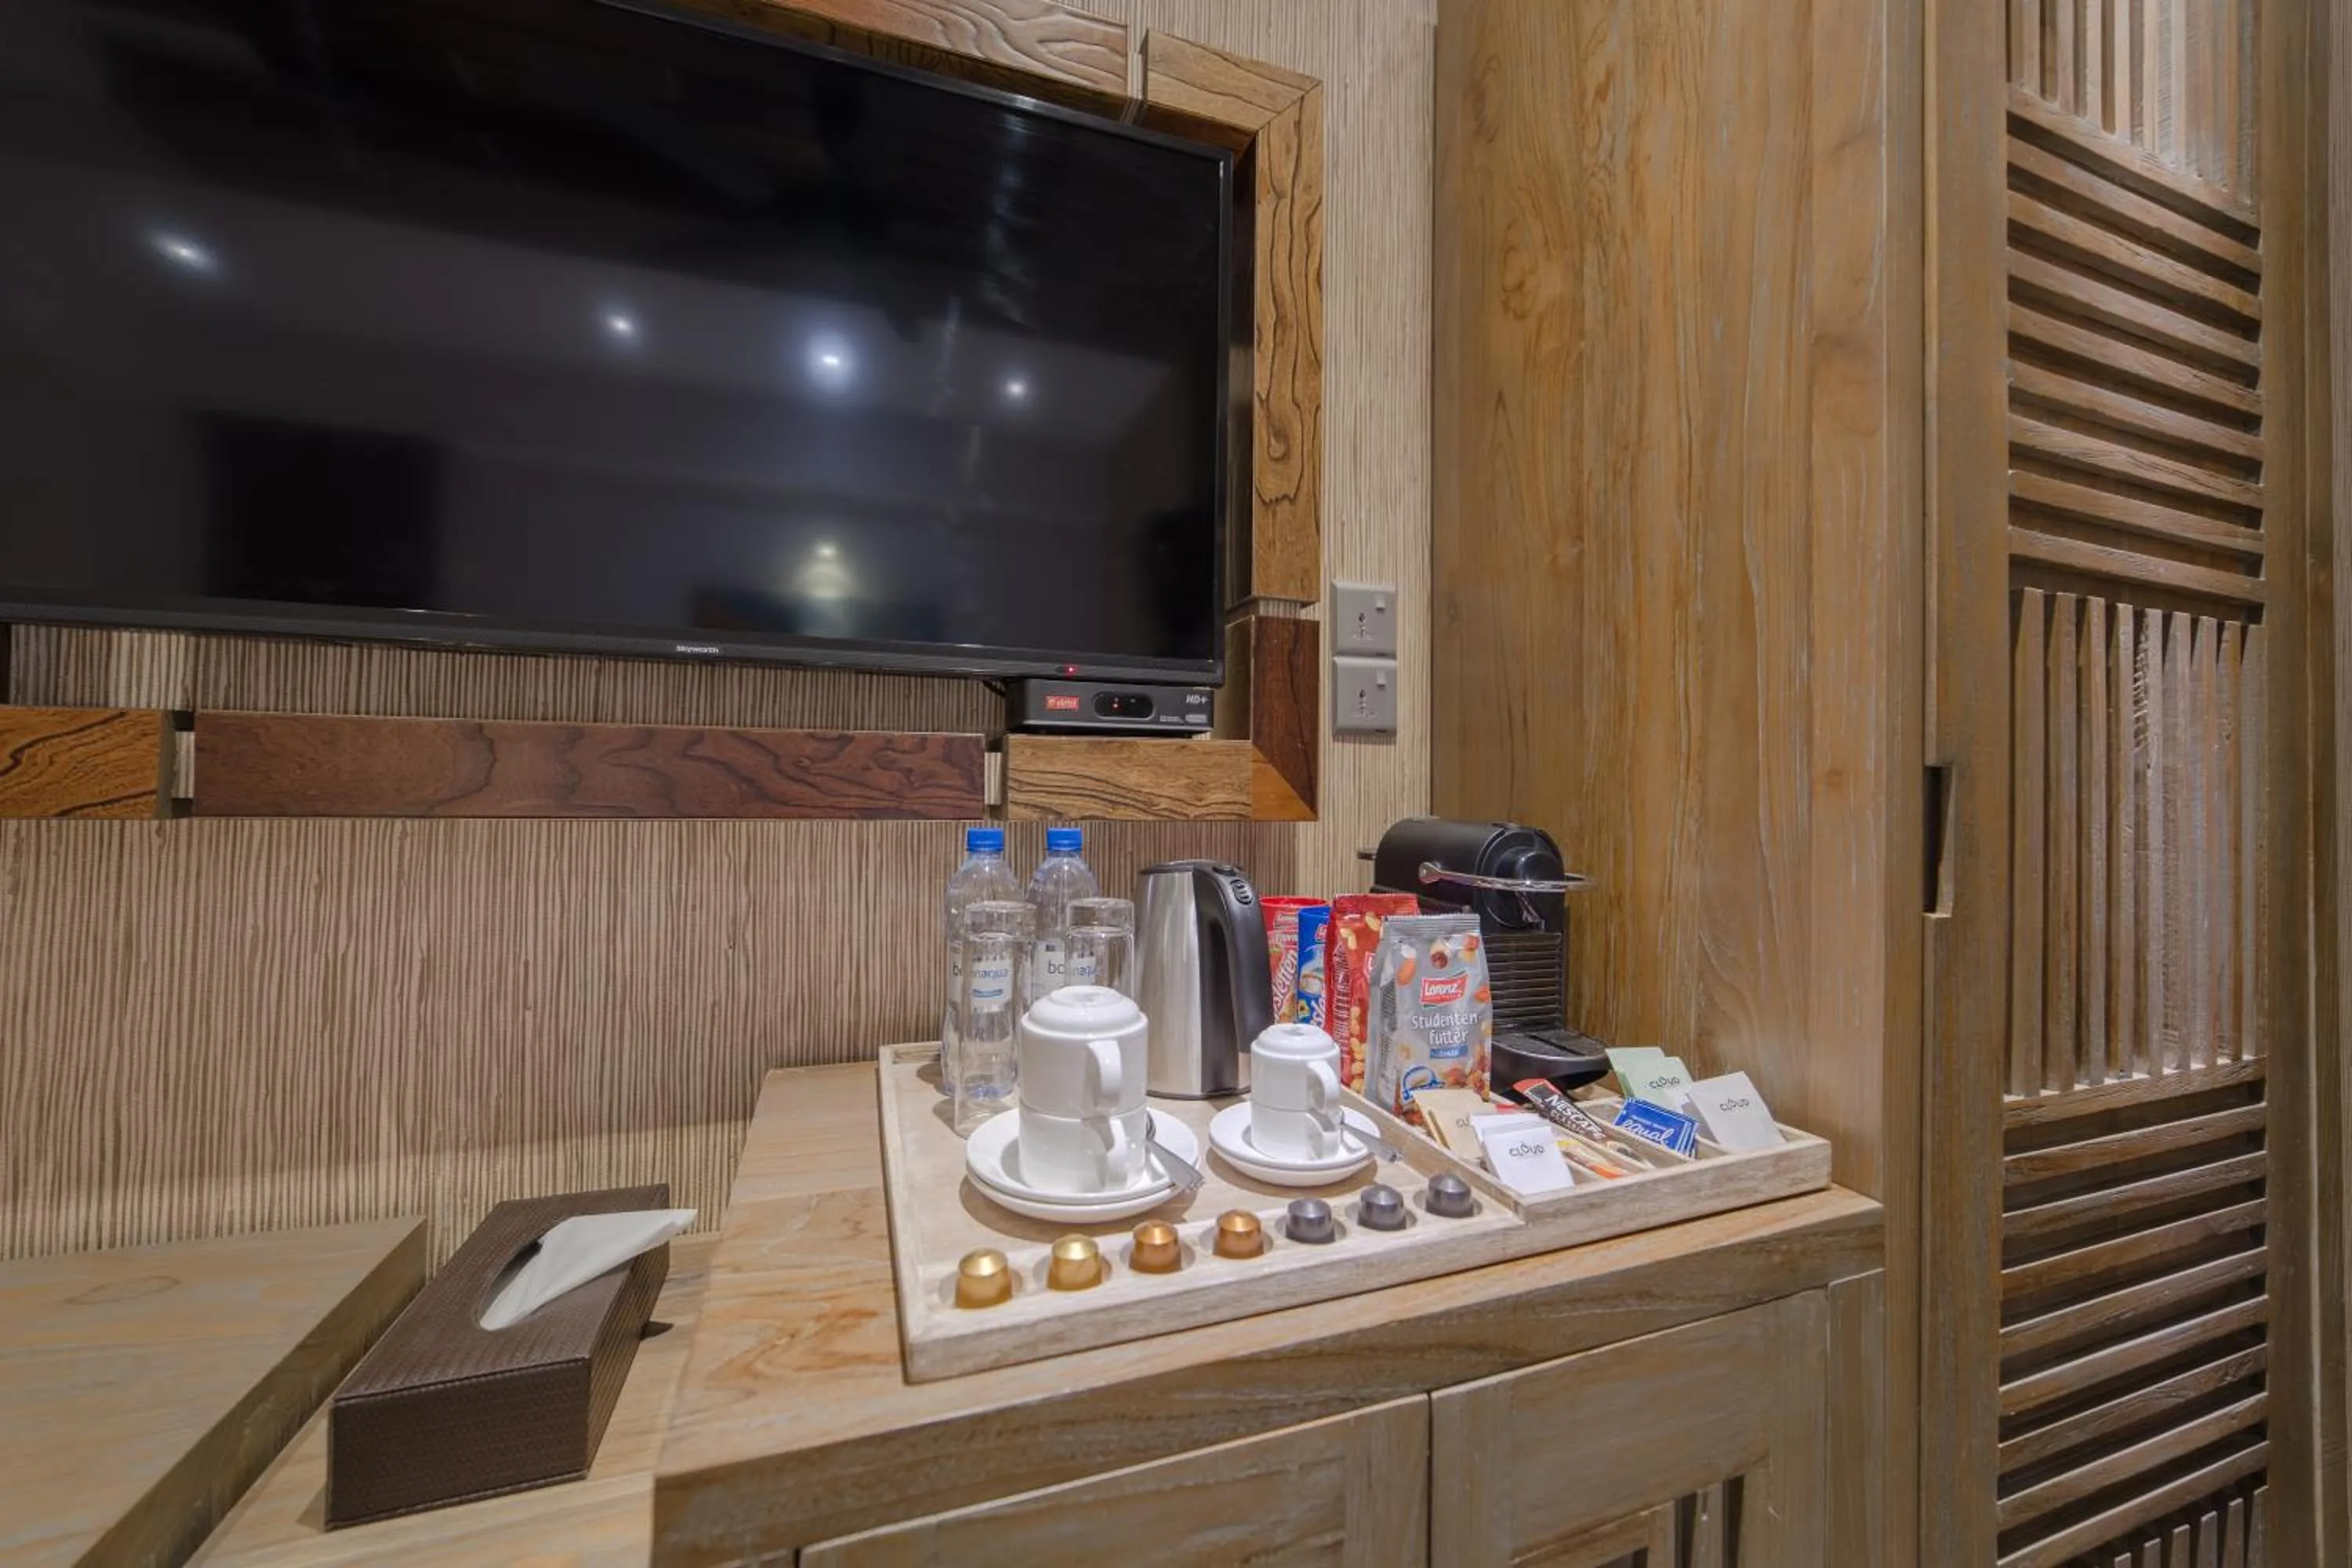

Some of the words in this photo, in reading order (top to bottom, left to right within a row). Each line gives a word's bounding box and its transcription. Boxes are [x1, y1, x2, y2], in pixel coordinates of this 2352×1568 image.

[1424, 982, 1459, 996] Lorenz
[1429, 1029, 1468, 1045] futter
[1648, 1076, 1681, 1090] CLOUD
[1719, 1098, 1750, 1112] CLOUD
[1622, 1118, 1675, 1145] equal
[1509, 1141, 1544, 1156] CLOUD
